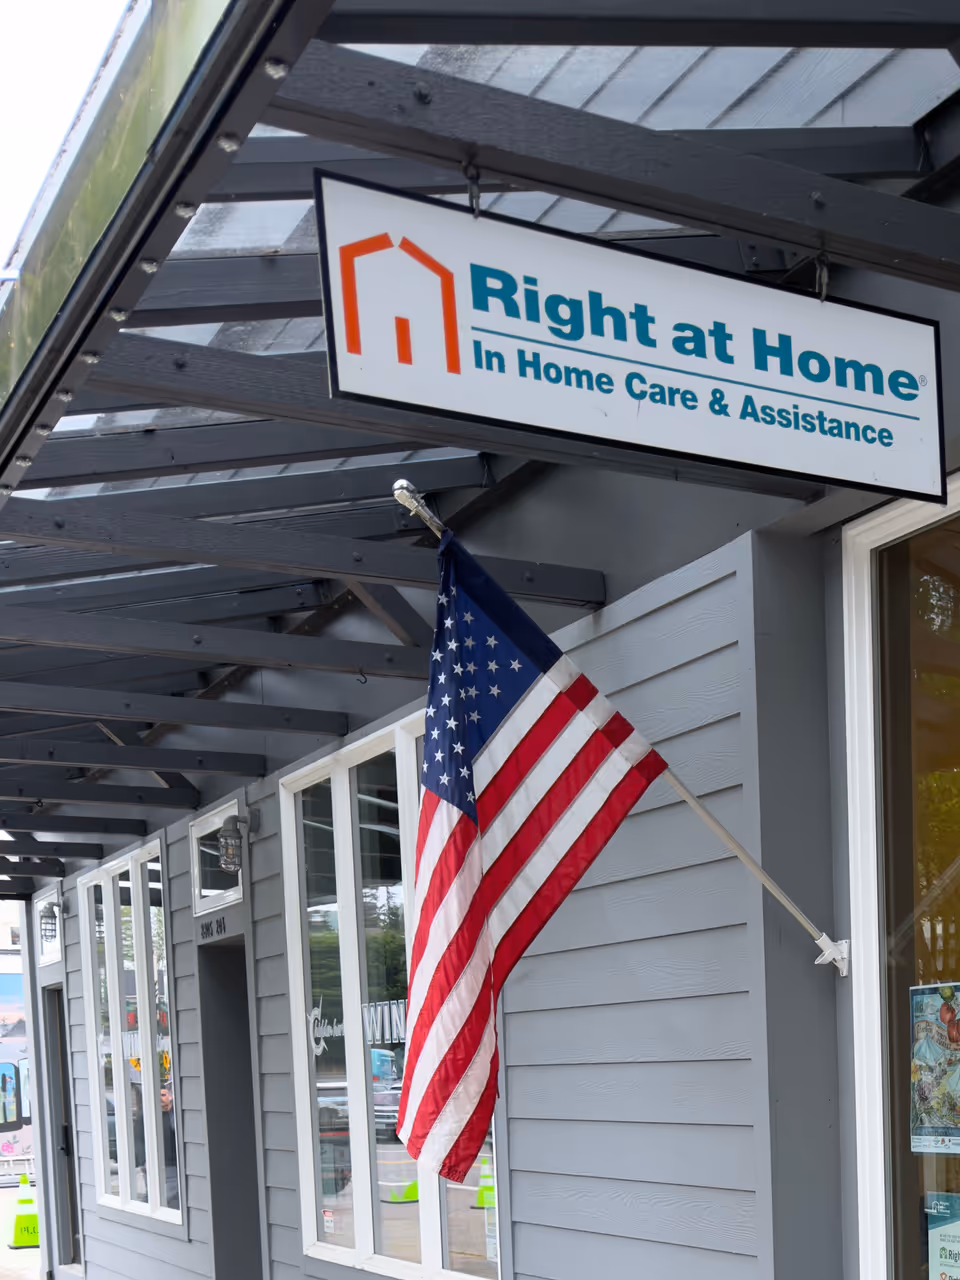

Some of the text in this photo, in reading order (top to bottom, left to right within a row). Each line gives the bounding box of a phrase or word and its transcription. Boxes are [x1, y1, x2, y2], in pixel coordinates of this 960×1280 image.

[469, 263, 658, 349] Right
[671, 320, 735, 365] at
[473, 340, 894, 447] In Home Care & Assistance
[361, 999, 408, 1045] WIN
